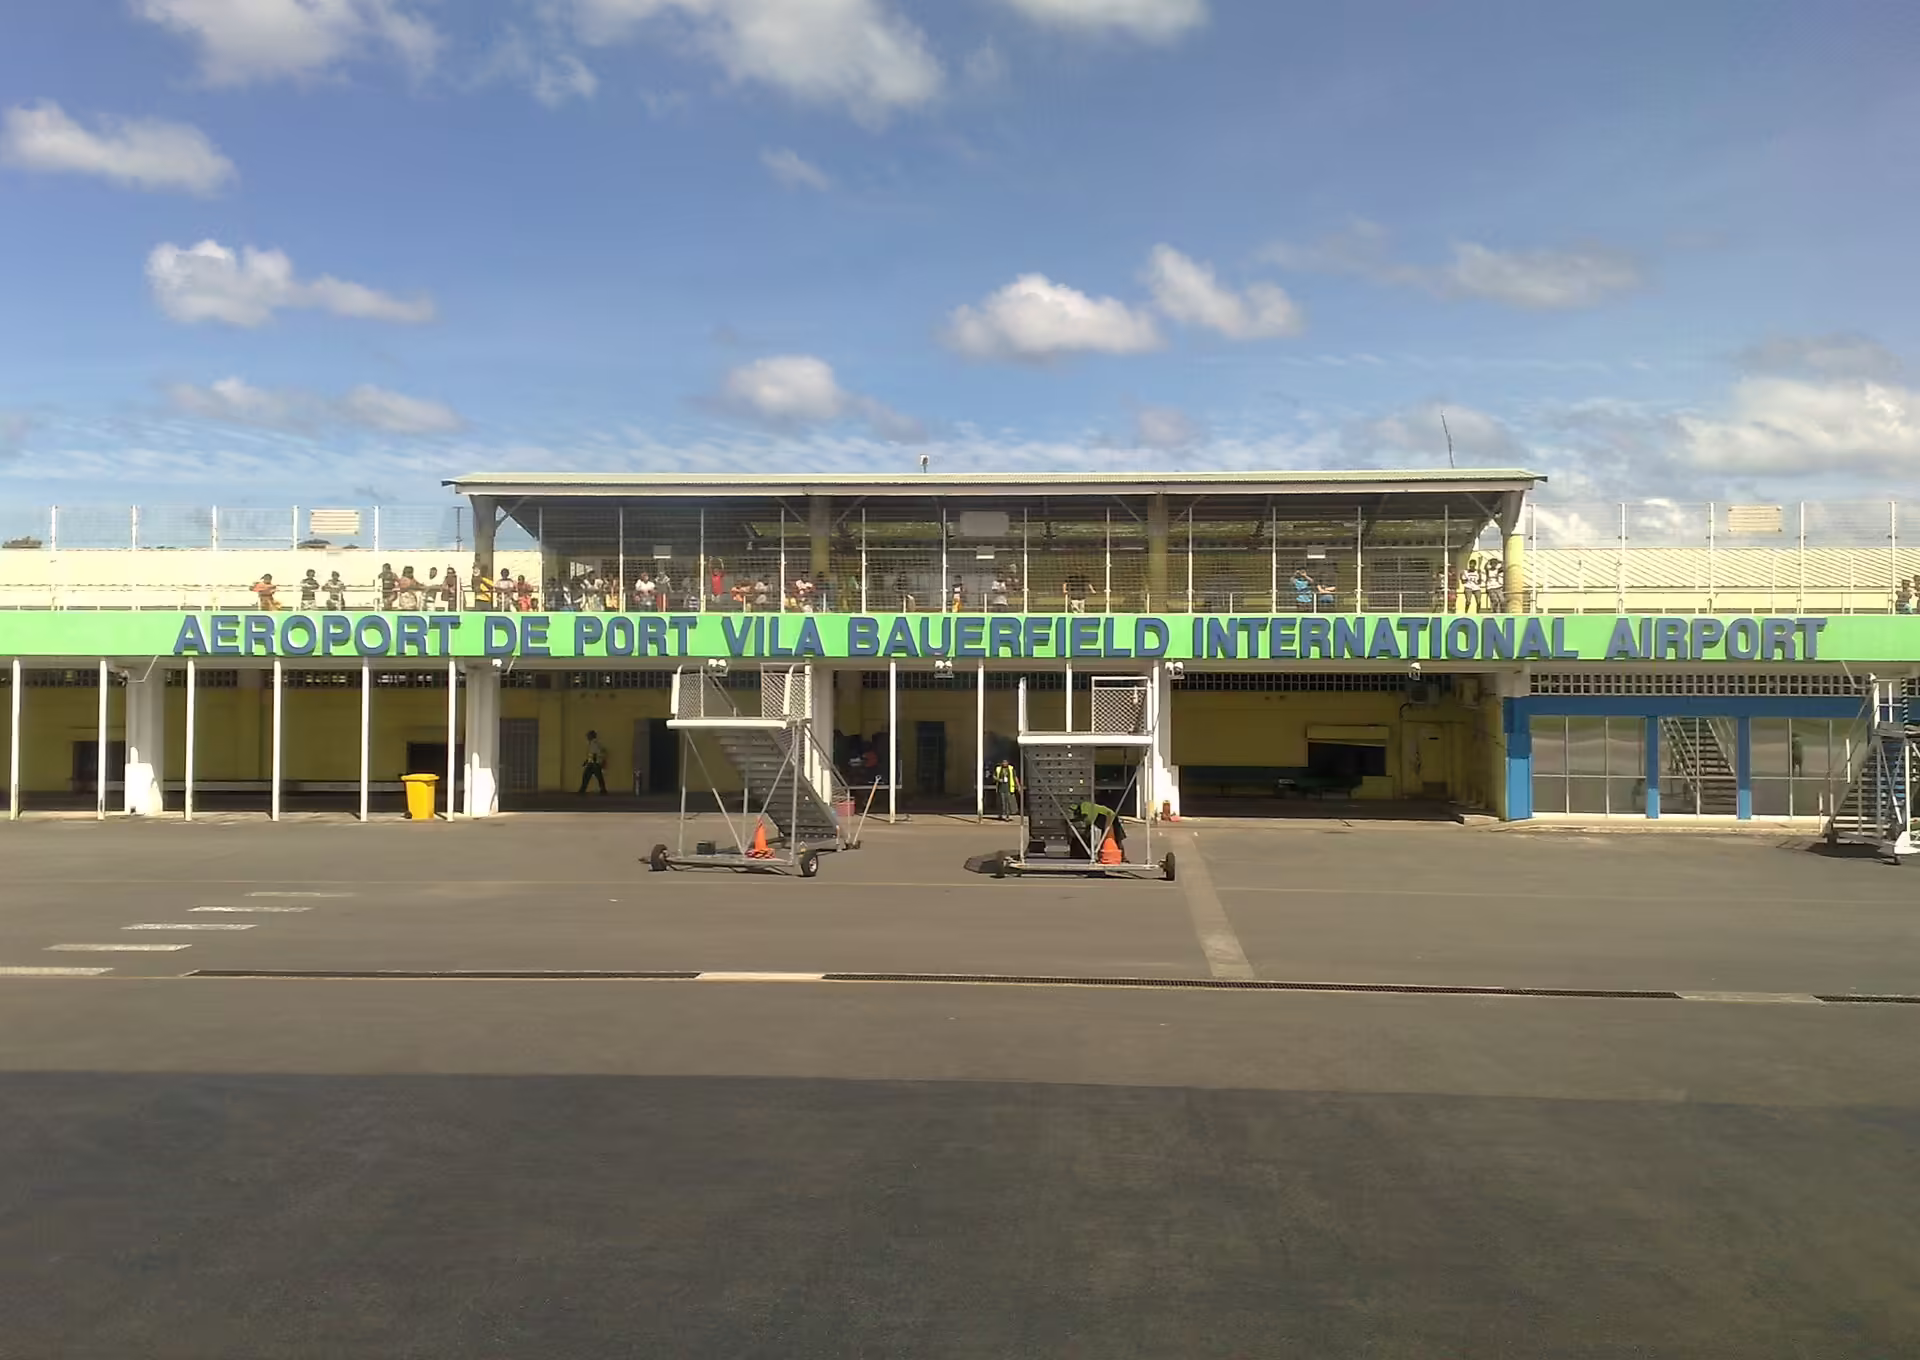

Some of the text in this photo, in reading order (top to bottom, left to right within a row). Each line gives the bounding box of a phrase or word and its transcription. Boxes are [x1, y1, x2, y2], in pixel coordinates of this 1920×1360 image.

[173, 615, 1828, 662] AEROPORT DE PORT VILA BAUERFIELD INTERNATIONAL AIRPORT
